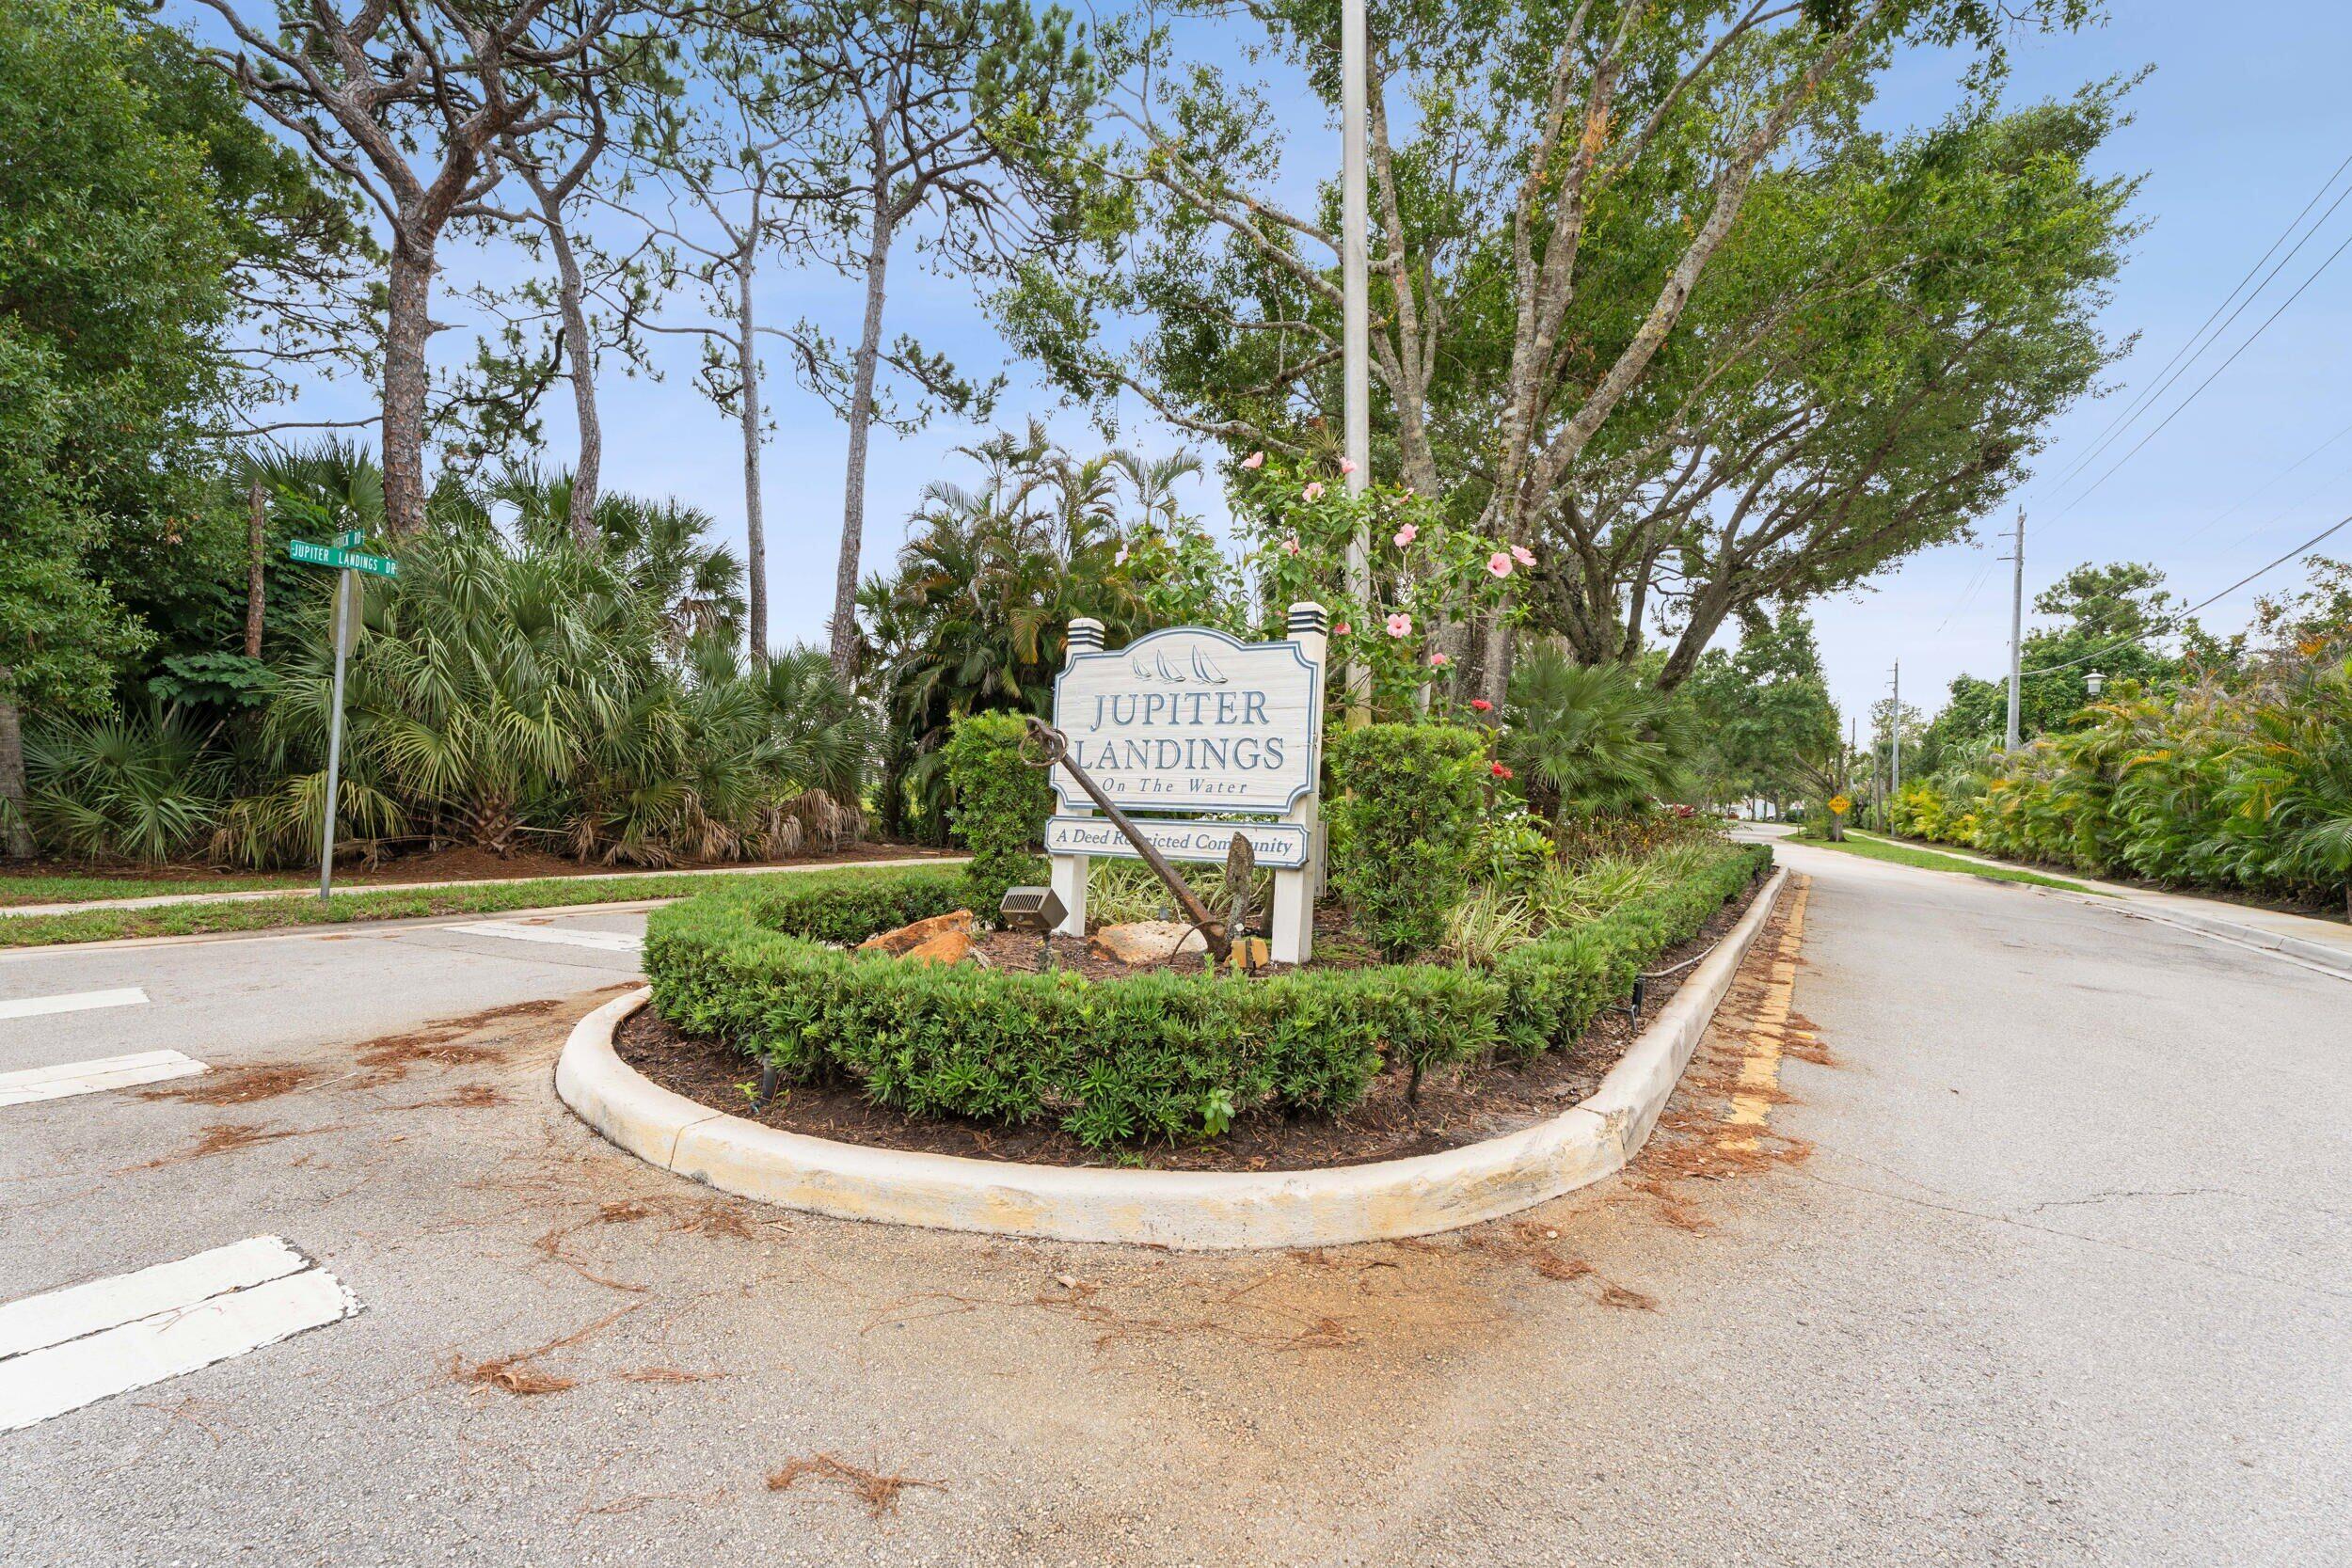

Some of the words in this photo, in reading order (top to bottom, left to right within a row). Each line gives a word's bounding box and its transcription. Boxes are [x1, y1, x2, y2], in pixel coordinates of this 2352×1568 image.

[293, 544, 329, 562] JUPITER
[339, 551, 378, 572] LANDINGS
[386, 562, 396, 575] DR
[1089, 690, 1270, 732] JUPITER
[1074, 736, 1284, 770] LANDINGS
[1102, 777, 1125, 792] On
[1140, 778, 1173, 793] The
[1188, 778, 1248, 794] Water
[1056, 828, 1068, 842] A
[1073, 829, 1110, 845] Deed
[1195, 833, 1293, 856] Comunity
